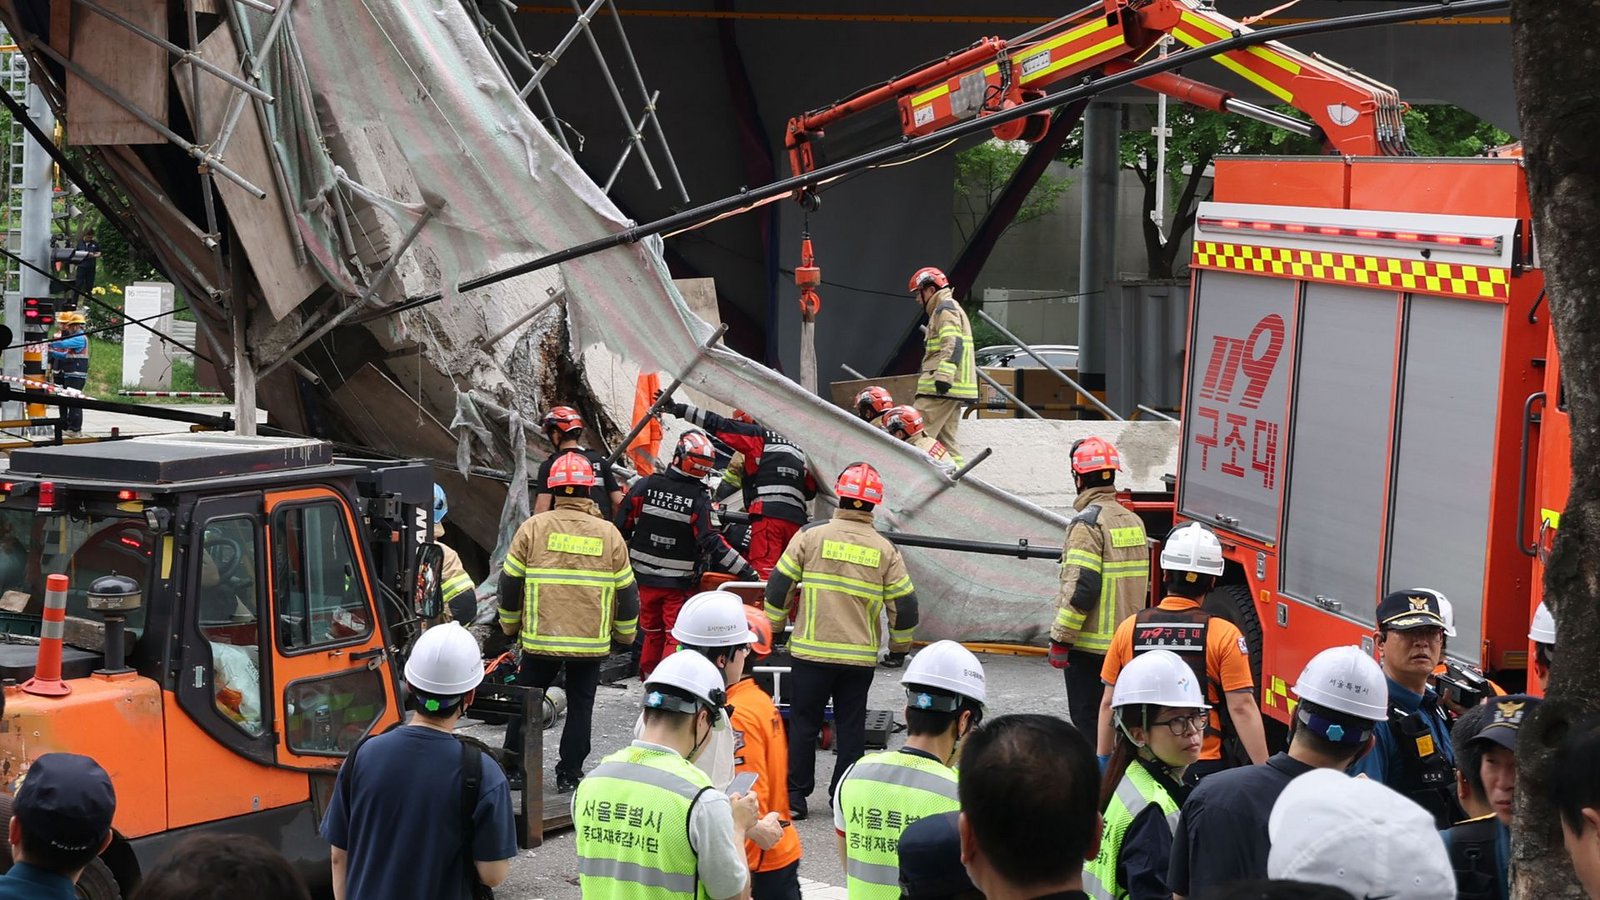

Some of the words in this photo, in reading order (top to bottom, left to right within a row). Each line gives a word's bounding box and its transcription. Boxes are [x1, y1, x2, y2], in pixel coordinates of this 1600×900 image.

[1199, 313, 1285, 410] 119
[1195, 405, 1278, 490] 구조대
[647, 488, 694, 508] 119구조대
[650, 498, 690, 512] RESCUE
[1328, 679, 1369, 695] 서울특별시
[582, 800, 663, 833] 서울특별시
